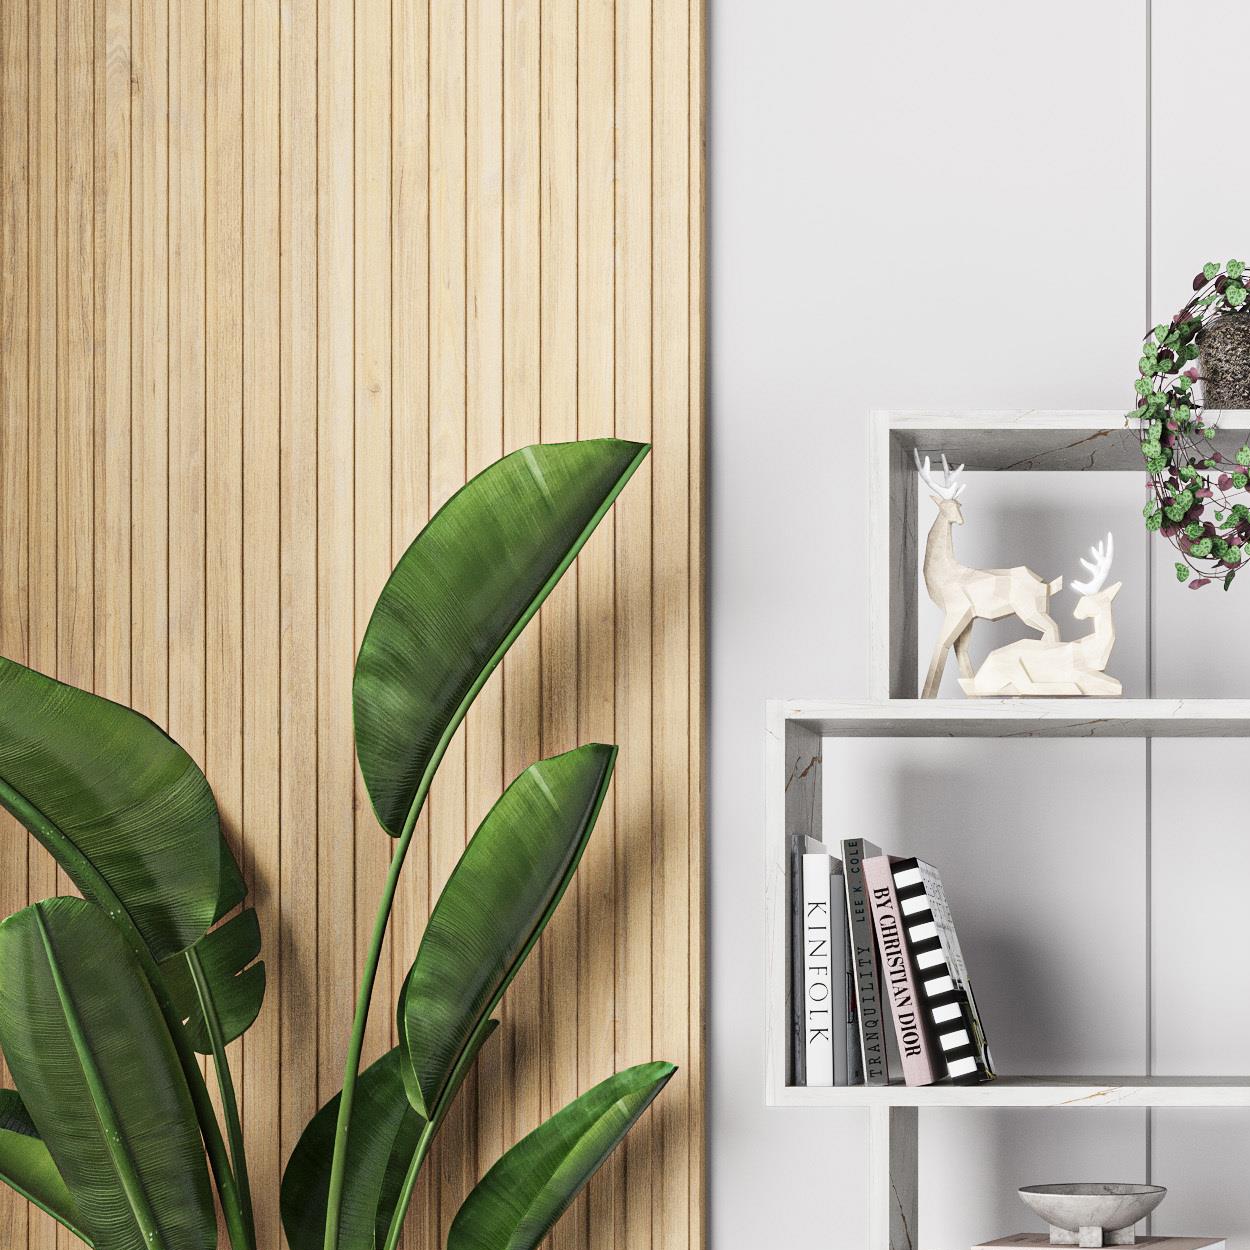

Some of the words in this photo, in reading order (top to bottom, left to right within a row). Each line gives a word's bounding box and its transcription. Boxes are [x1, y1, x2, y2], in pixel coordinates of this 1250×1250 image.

[848, 841, 861, 873] COLE
[856, 900, 864, 922] LEE
[873, 886, 894, 910] BY
[807, 901, 830, 1045] KINFOLK
[879, 914, 912, 1008] CHRISTIAN
[857, 946, 883, 1078] TRANQUILITY
[898, 1011, 922, 1059] DIOR
